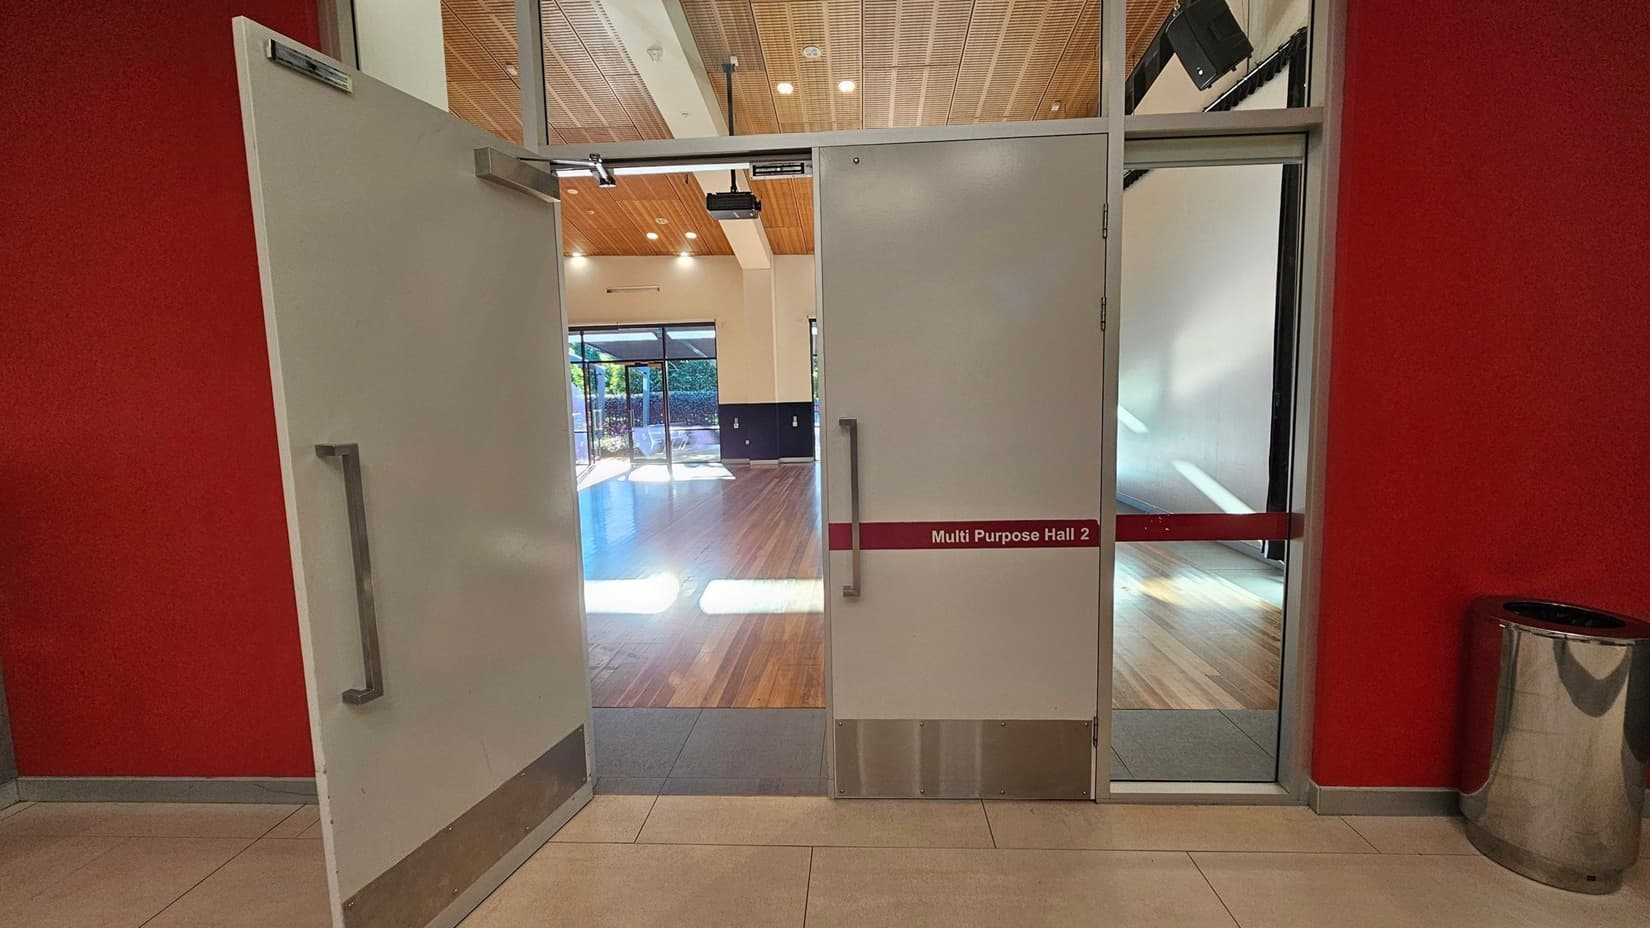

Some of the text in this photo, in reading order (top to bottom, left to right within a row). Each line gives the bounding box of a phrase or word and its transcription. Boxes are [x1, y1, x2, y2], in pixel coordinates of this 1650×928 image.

[931, 527, 1090, 545] Multi Purpose Hall 2
